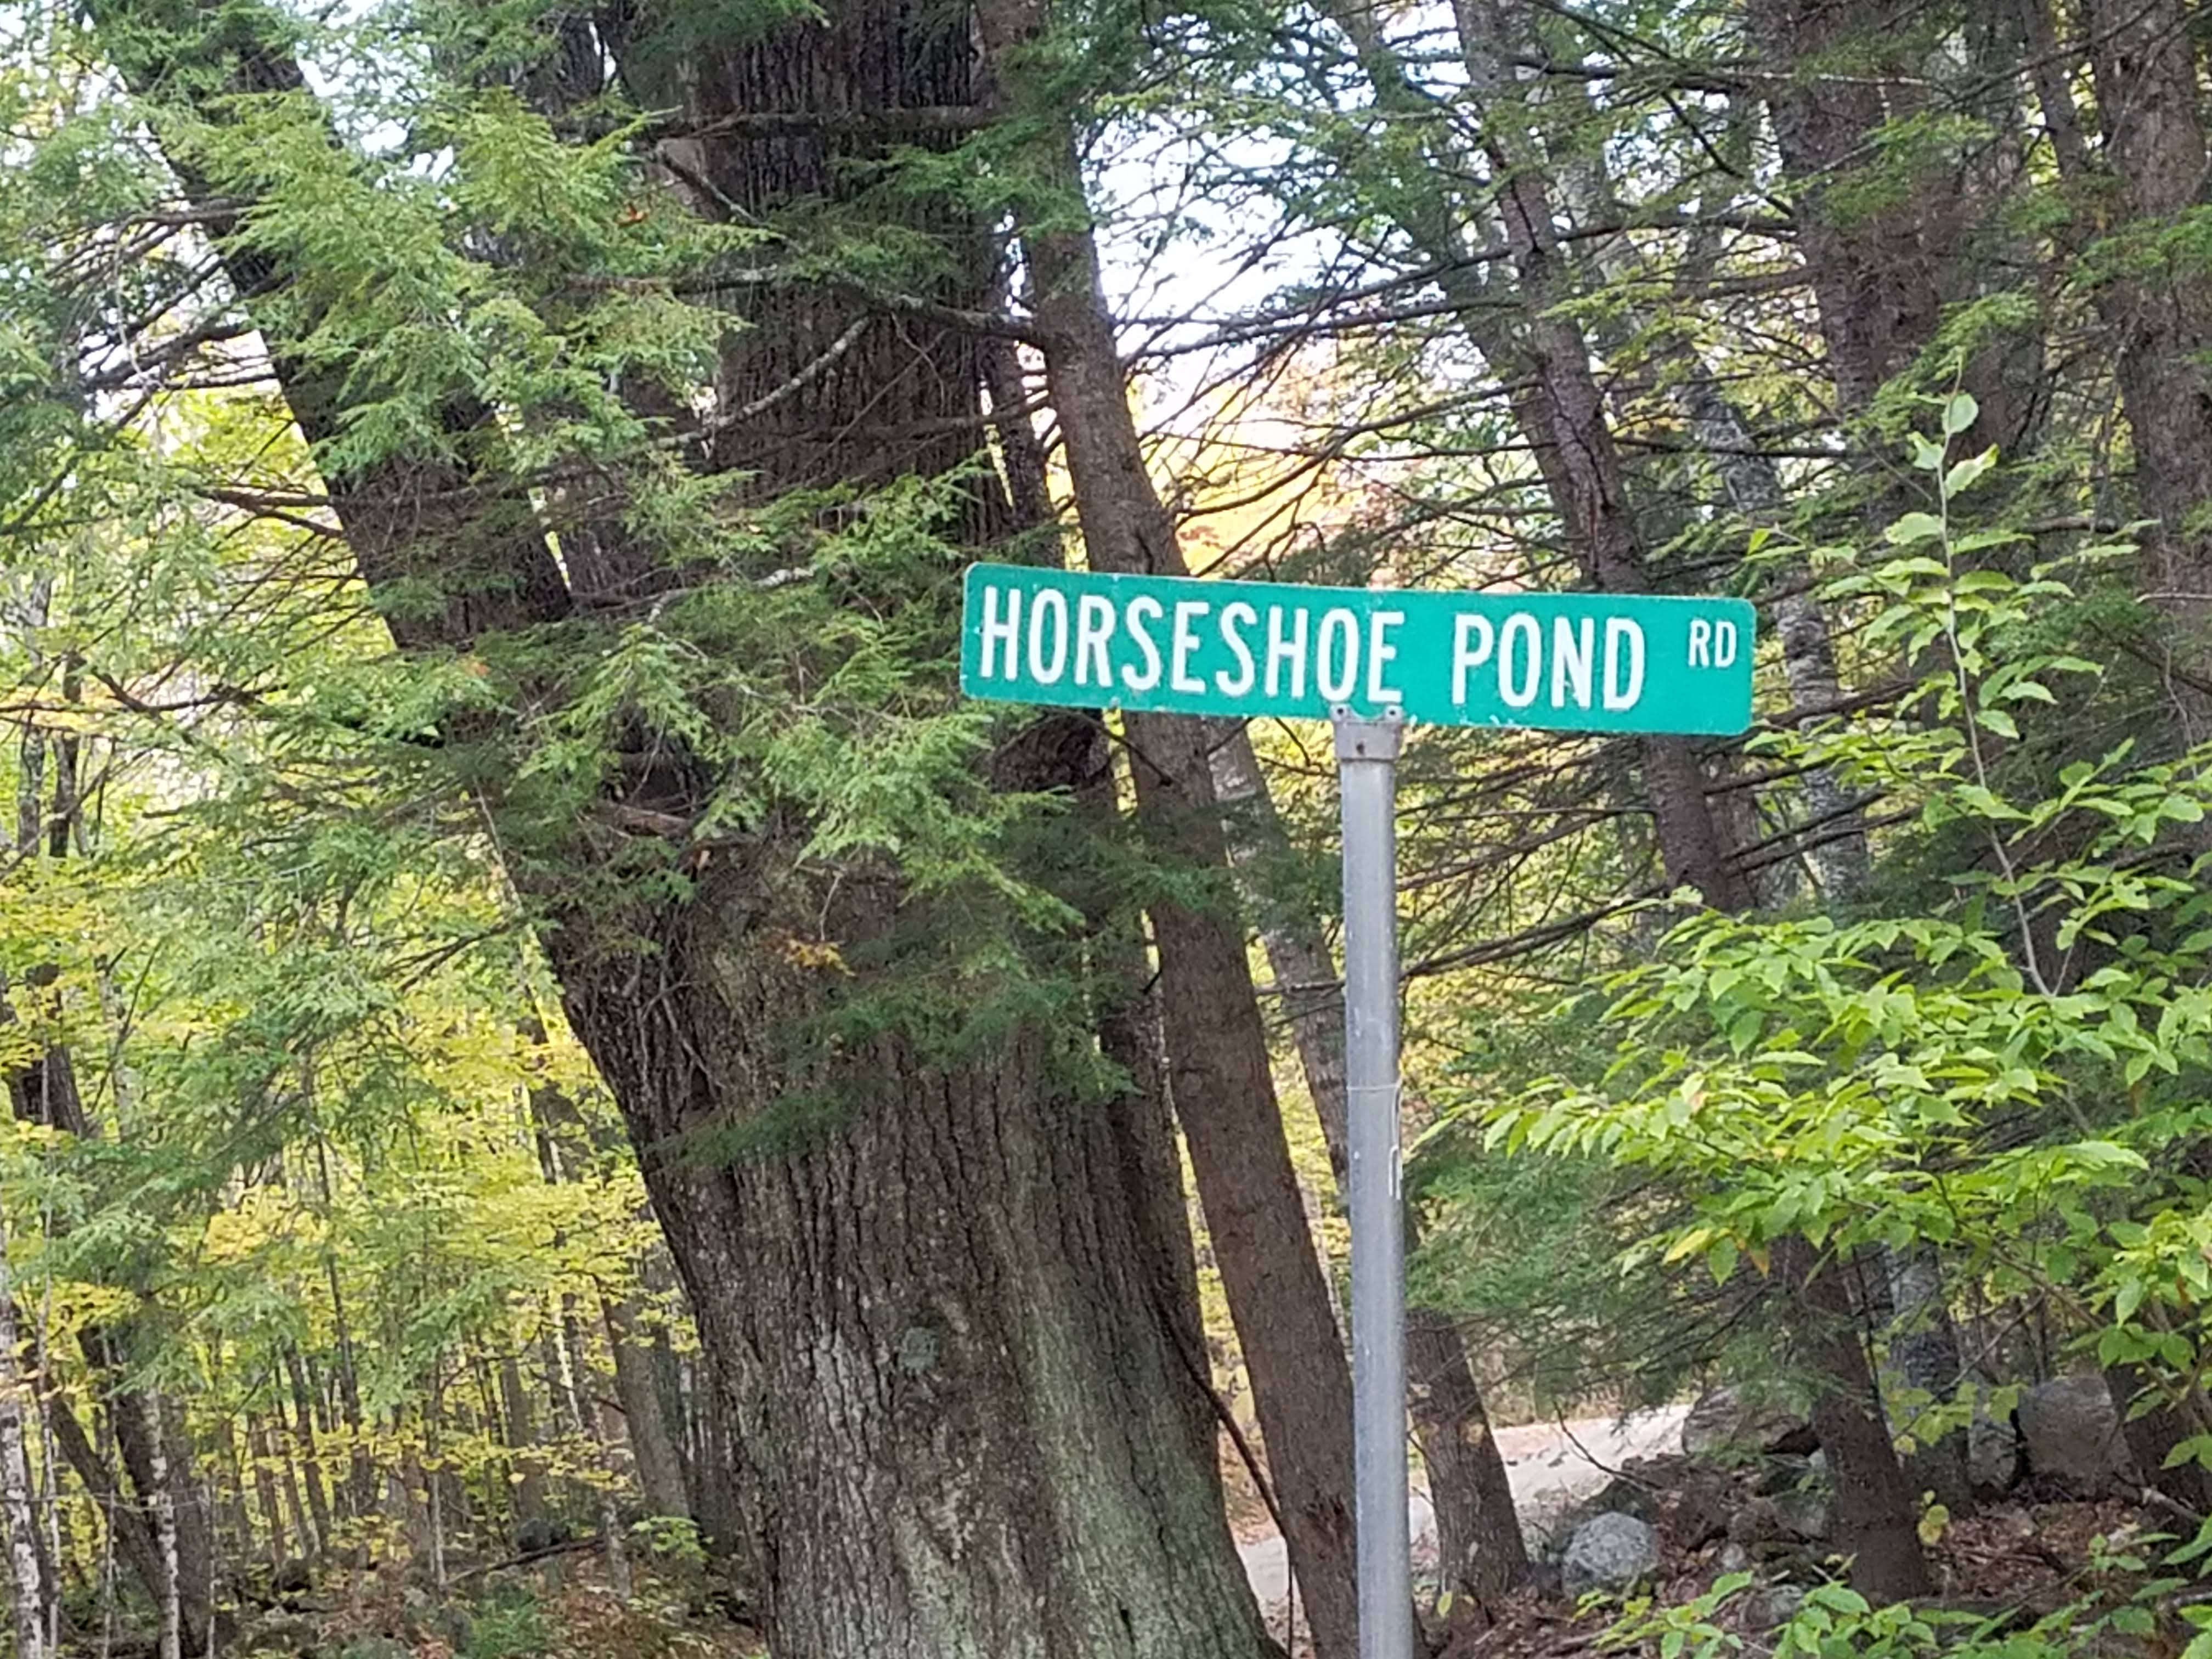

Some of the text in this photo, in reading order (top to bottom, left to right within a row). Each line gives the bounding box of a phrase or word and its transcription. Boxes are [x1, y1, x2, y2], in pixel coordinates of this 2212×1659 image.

[979, 586, 1737, 710] HORSESHOE POND RD
